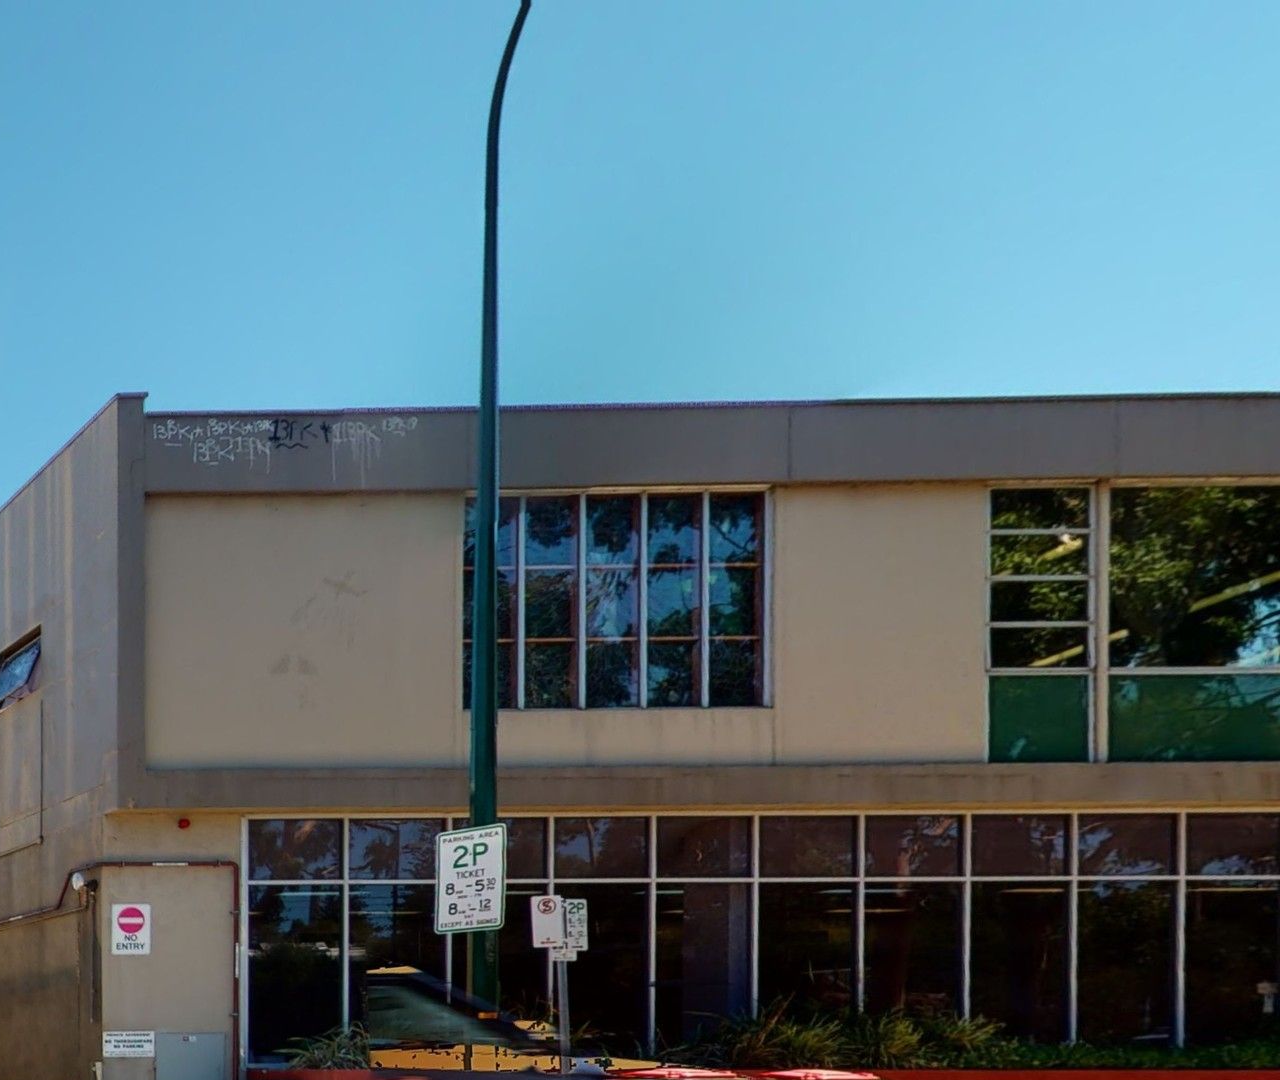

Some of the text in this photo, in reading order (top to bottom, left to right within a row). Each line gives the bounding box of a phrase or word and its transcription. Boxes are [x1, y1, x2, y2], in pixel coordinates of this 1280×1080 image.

[453, 843, 488, 869] 2P
[456, 869, 485, 879] TICKET
[441, 921, 462, 929] EXCEPT
[116, 942, 145, 950] ENTRY
